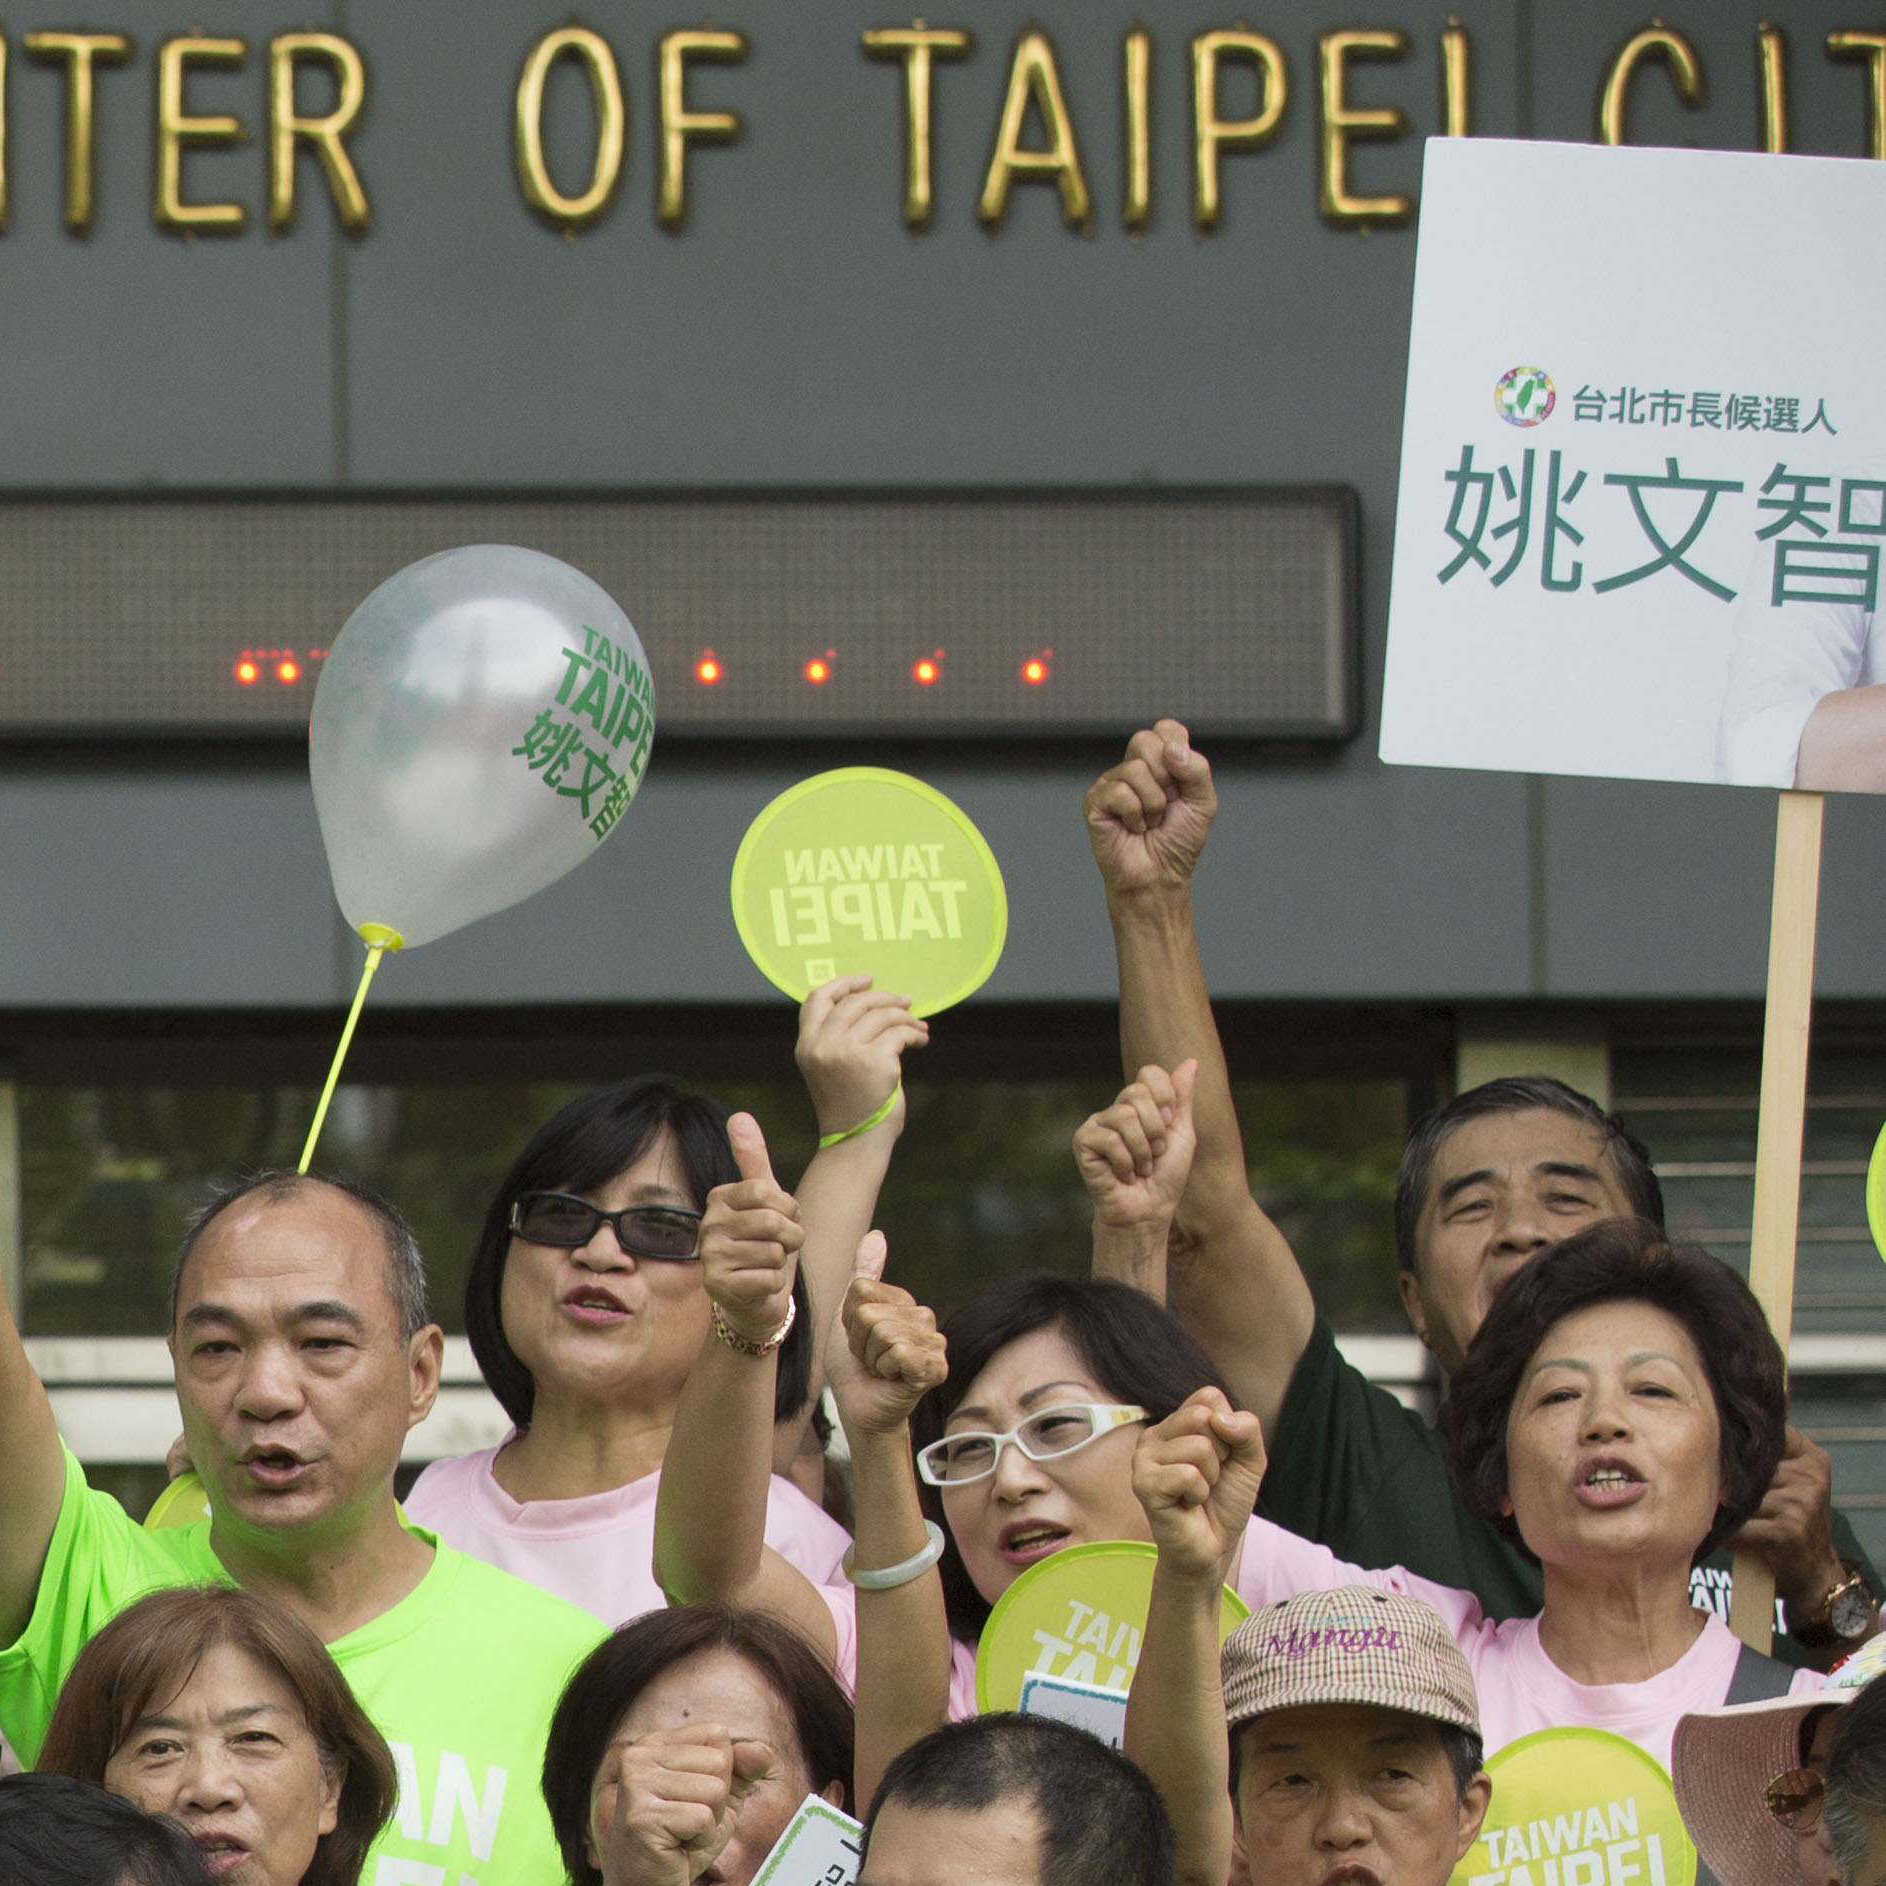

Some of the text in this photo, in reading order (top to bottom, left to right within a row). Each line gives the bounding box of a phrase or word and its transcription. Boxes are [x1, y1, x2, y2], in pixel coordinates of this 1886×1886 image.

[513, 27, 749, 228] OF
[1571, 384, 1840, 436] 台北市長候選人
[1435, 444, 1886, 614] 姚文智
[1480, 1797, 1640, 1870] TAIWAN
